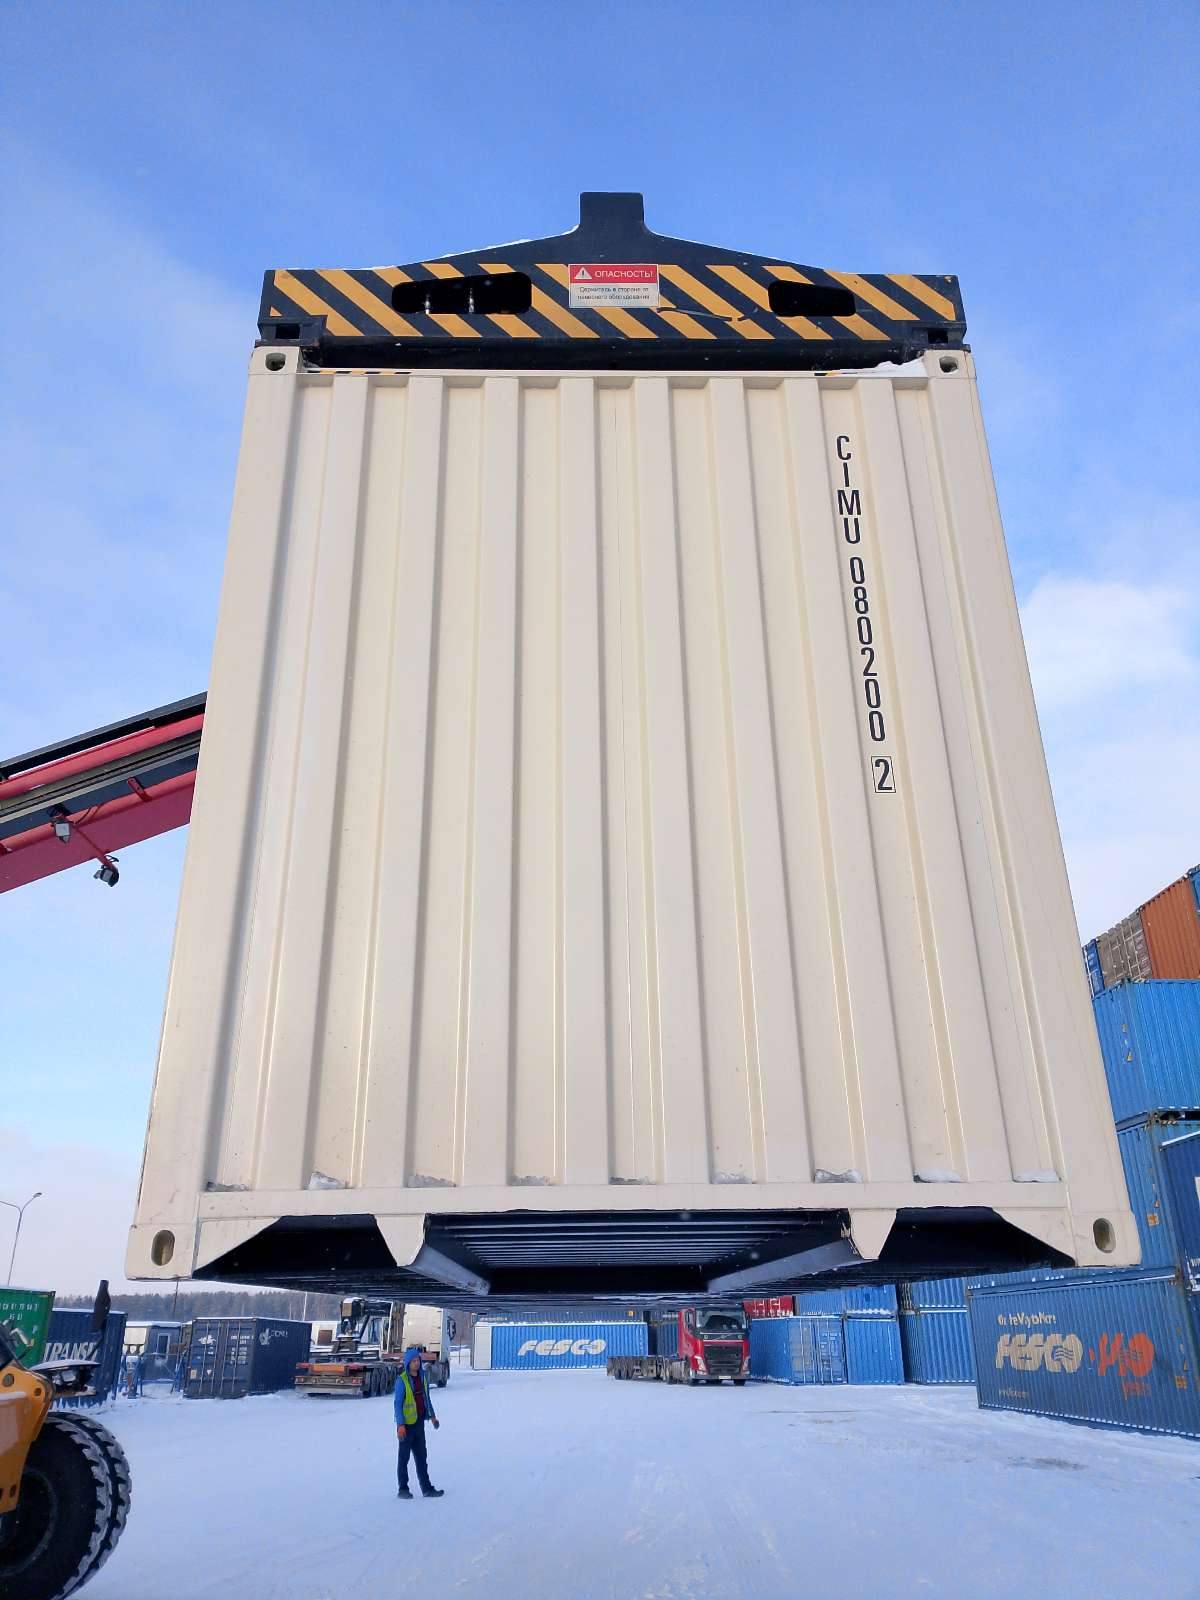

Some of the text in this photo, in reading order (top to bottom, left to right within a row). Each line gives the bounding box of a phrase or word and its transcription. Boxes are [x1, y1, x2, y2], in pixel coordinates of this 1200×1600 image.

[836, 435, 893, 791] CIMU 080200 2
[518, 1339, 607, 1356] FESCO
[996, 1333, 1083, 1374] FESCO
